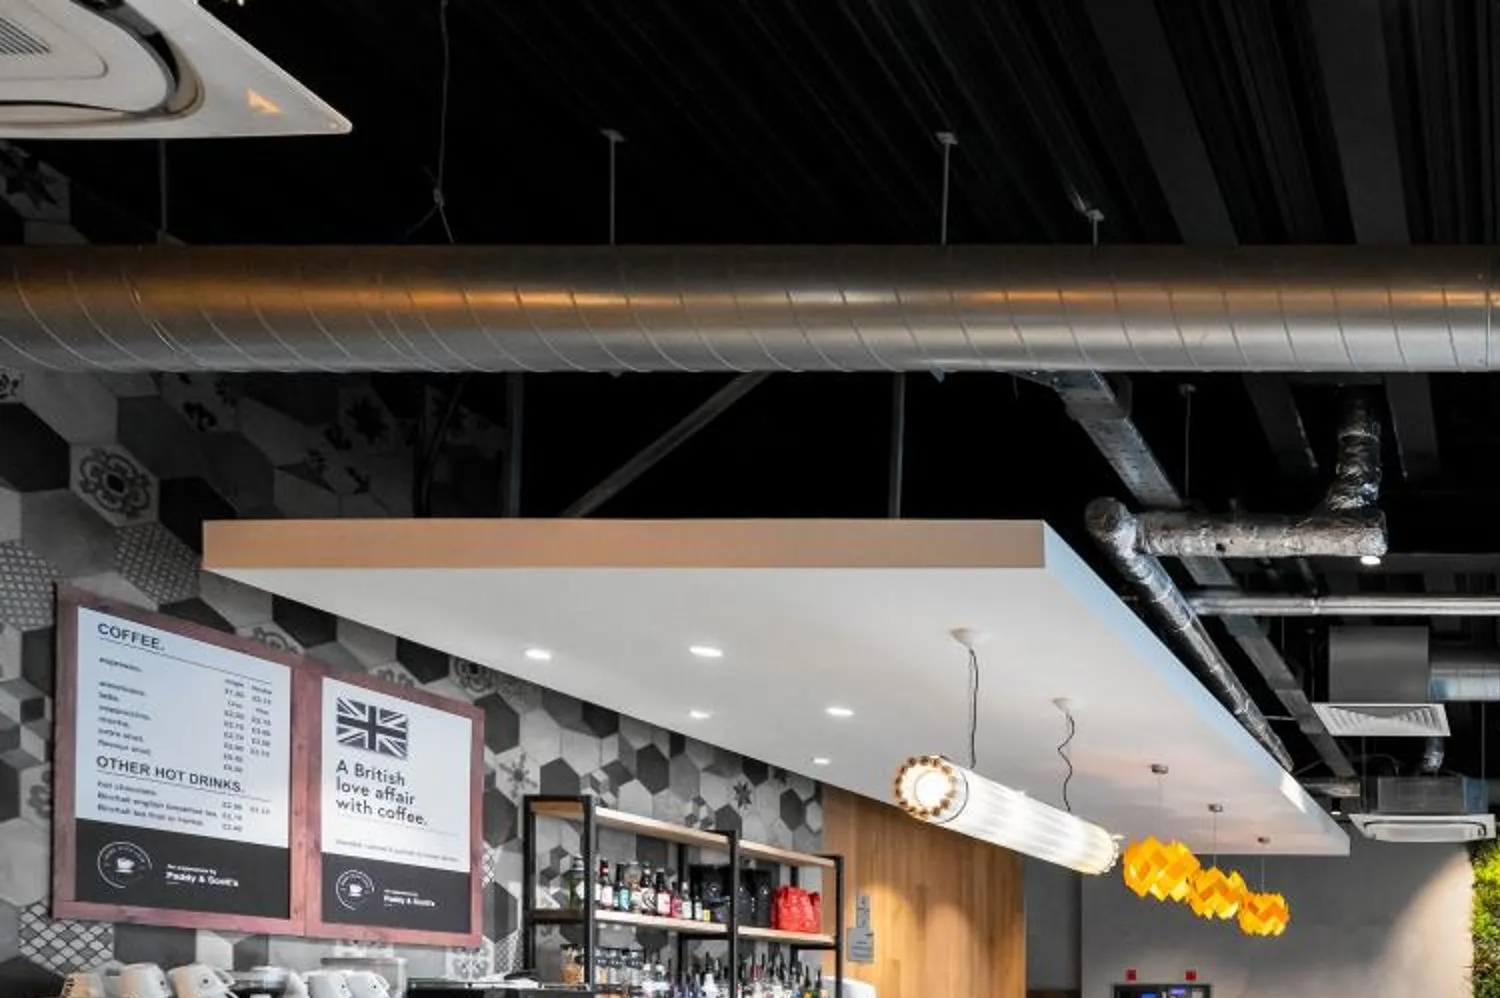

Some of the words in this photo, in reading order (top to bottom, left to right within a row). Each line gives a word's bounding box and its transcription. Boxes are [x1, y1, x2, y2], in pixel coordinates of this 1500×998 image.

[97, 623, 165, 651] COFFEE.
[96, 755, 151, 777] OTHER
[155, 766, 186, 782] HOT
[335, 759, 349, 774] A
[354, 763, 405, 787] British
[335, 777, 370, 797] love
[375, 785, 416, 806] affair
[335, 799, 373, 815] with
[377, 806, 428, 826] coffee.
